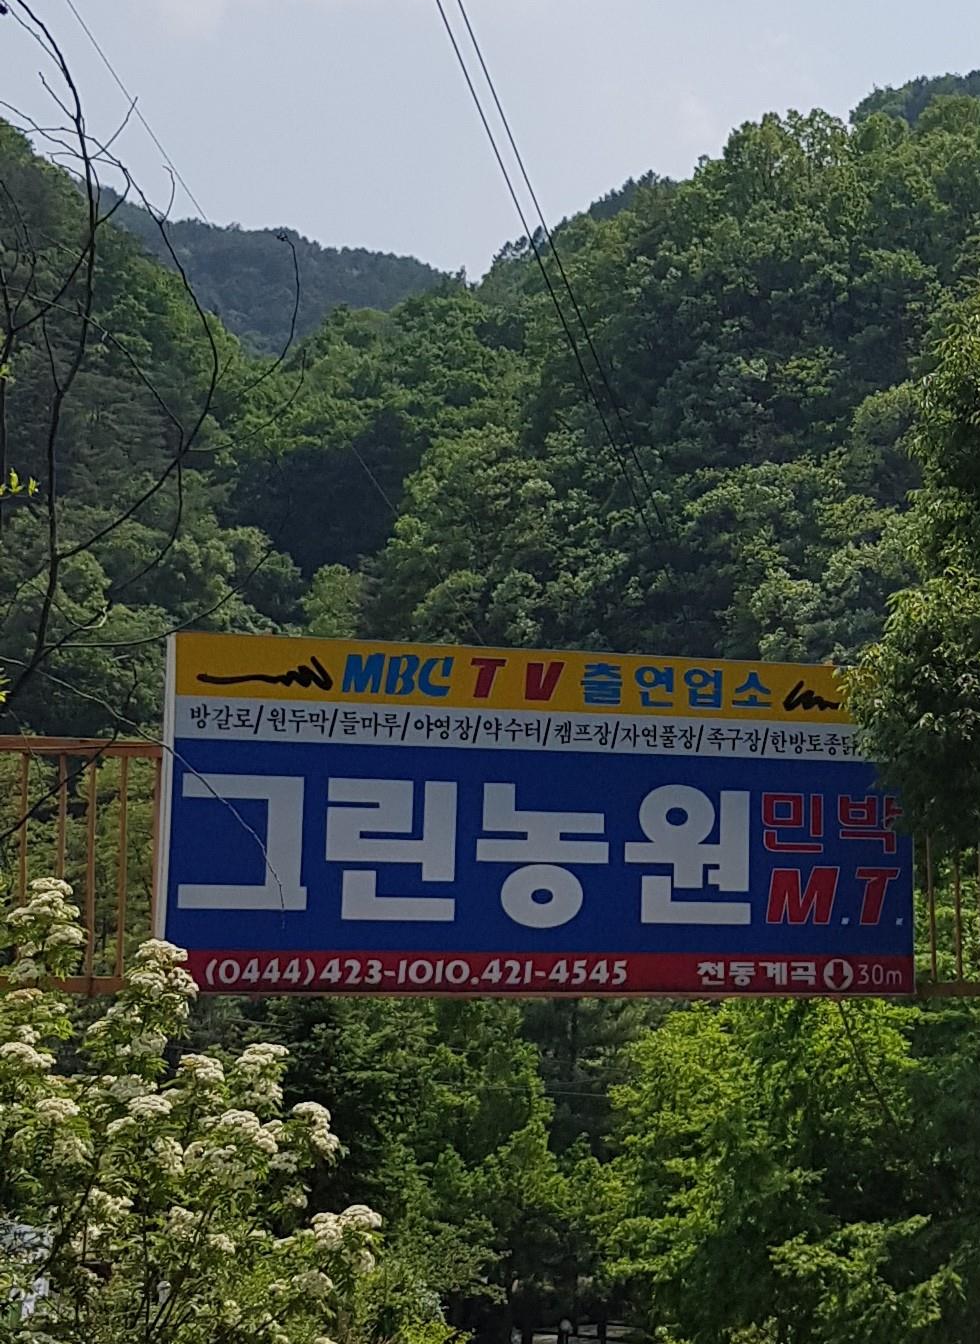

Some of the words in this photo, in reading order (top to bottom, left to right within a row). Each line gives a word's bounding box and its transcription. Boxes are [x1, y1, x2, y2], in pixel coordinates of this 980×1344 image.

[341, 653, 455, 697] MBC
[580, 662, 773, 710] 출연업소
[177, 772, 751, 929] 그린농원
[761, 792, 903, 854] 민박
[697, 959, 817, 987] 천동계곡
[857, 963, 903, 987] 30m
